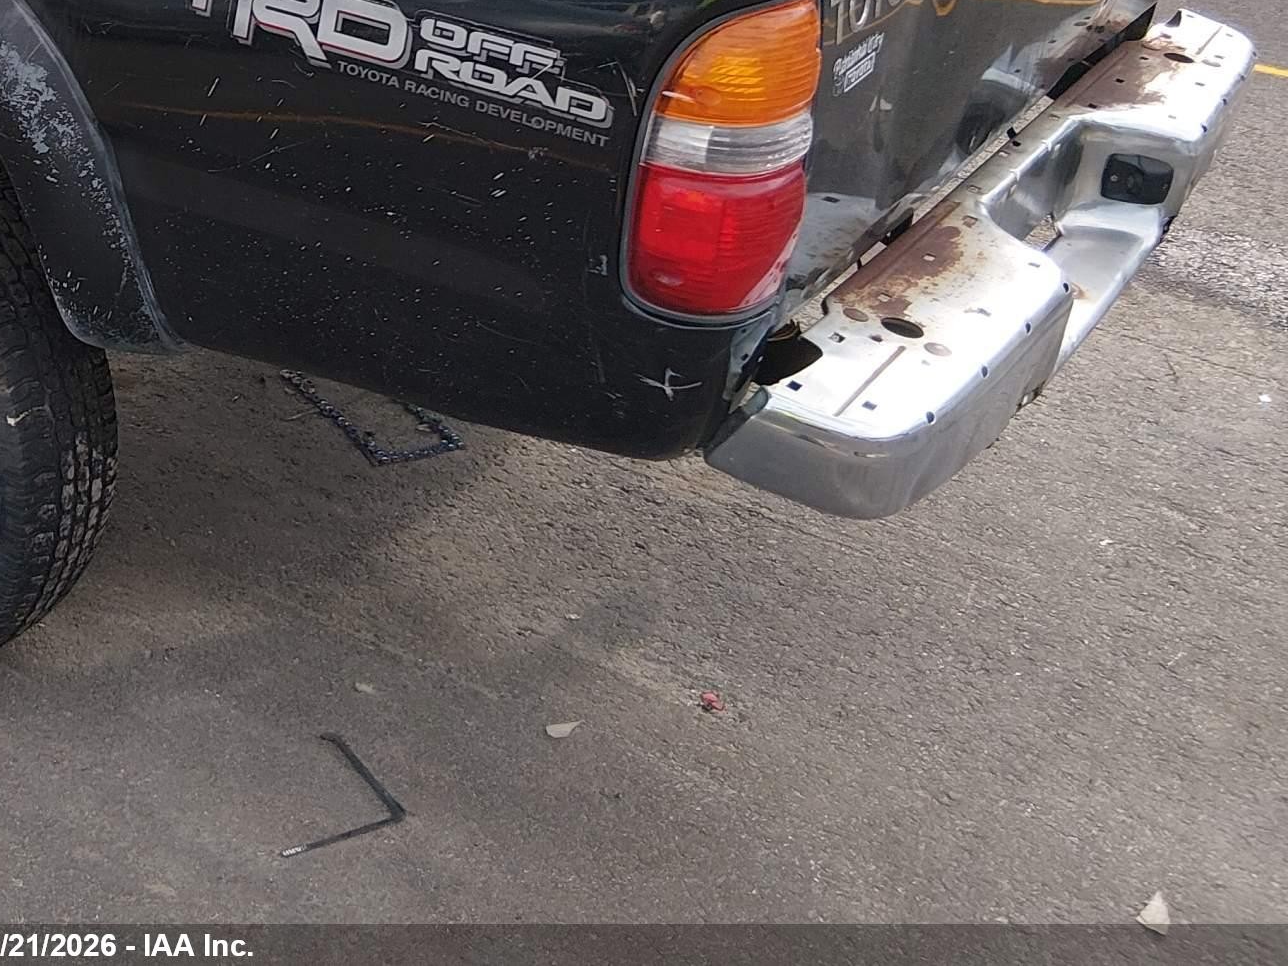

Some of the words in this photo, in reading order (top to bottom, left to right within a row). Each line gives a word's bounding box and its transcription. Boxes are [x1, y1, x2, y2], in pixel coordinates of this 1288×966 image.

[420, 17, 566, 74] OFF
[336, 60, 400, 89] TOYOTA
[403, 79, 471, 109] RACING
[475, 100, 610, 147] DEVELOPMENT
[414, 48, 614, 129] ROAD
